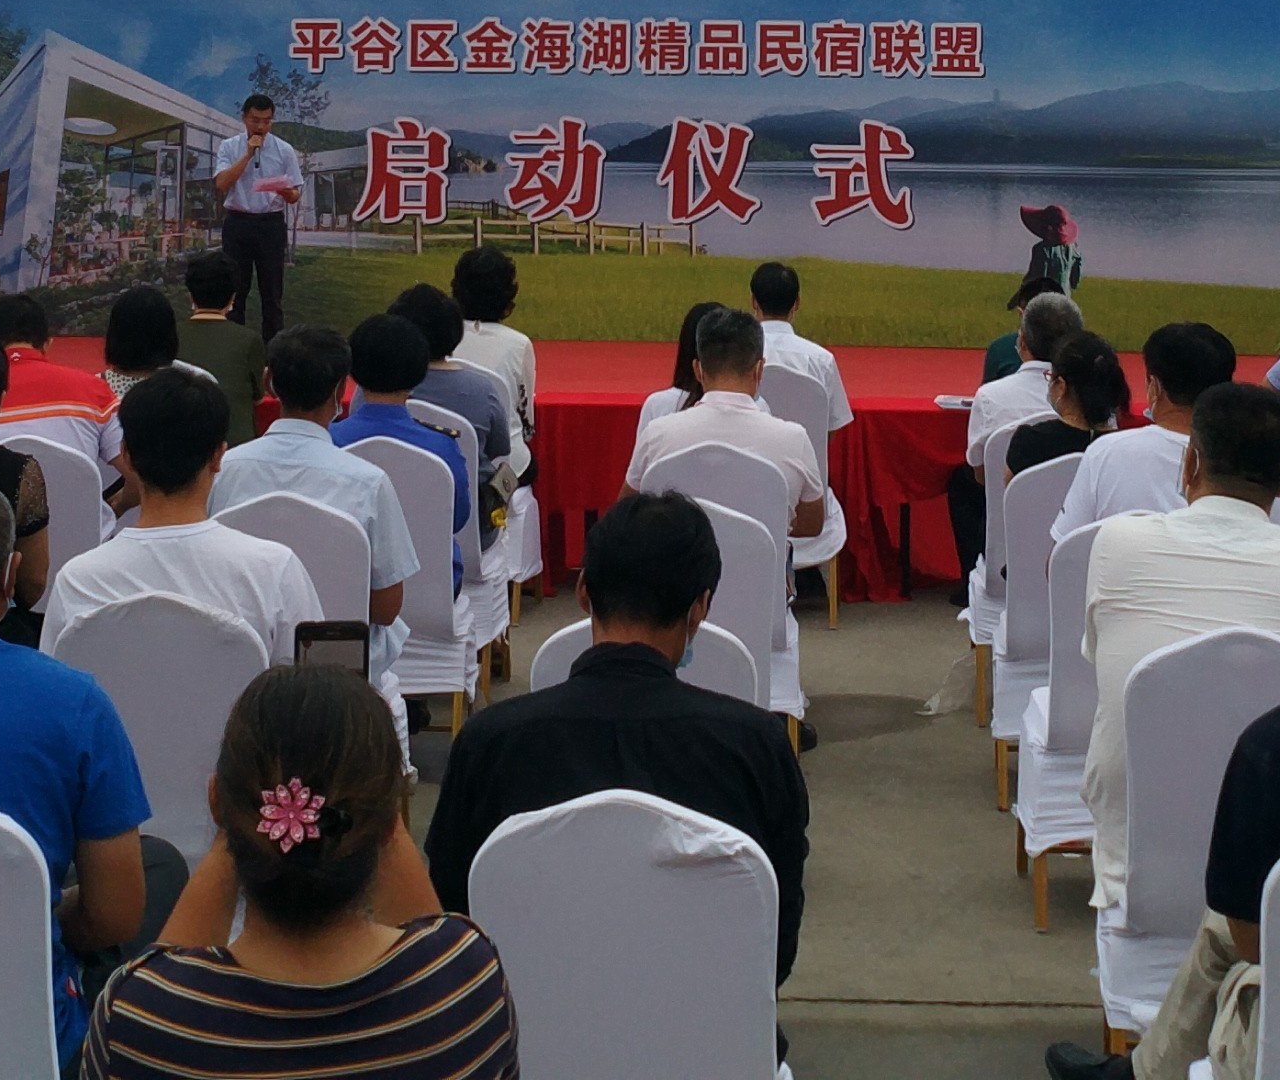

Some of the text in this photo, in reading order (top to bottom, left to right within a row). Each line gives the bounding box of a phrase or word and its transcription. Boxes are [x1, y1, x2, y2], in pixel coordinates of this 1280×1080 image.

[289, 17, 986, 79] 平谷区金海湖精品民宿联盟
[353, 119, 917, 228] 启动仪式
